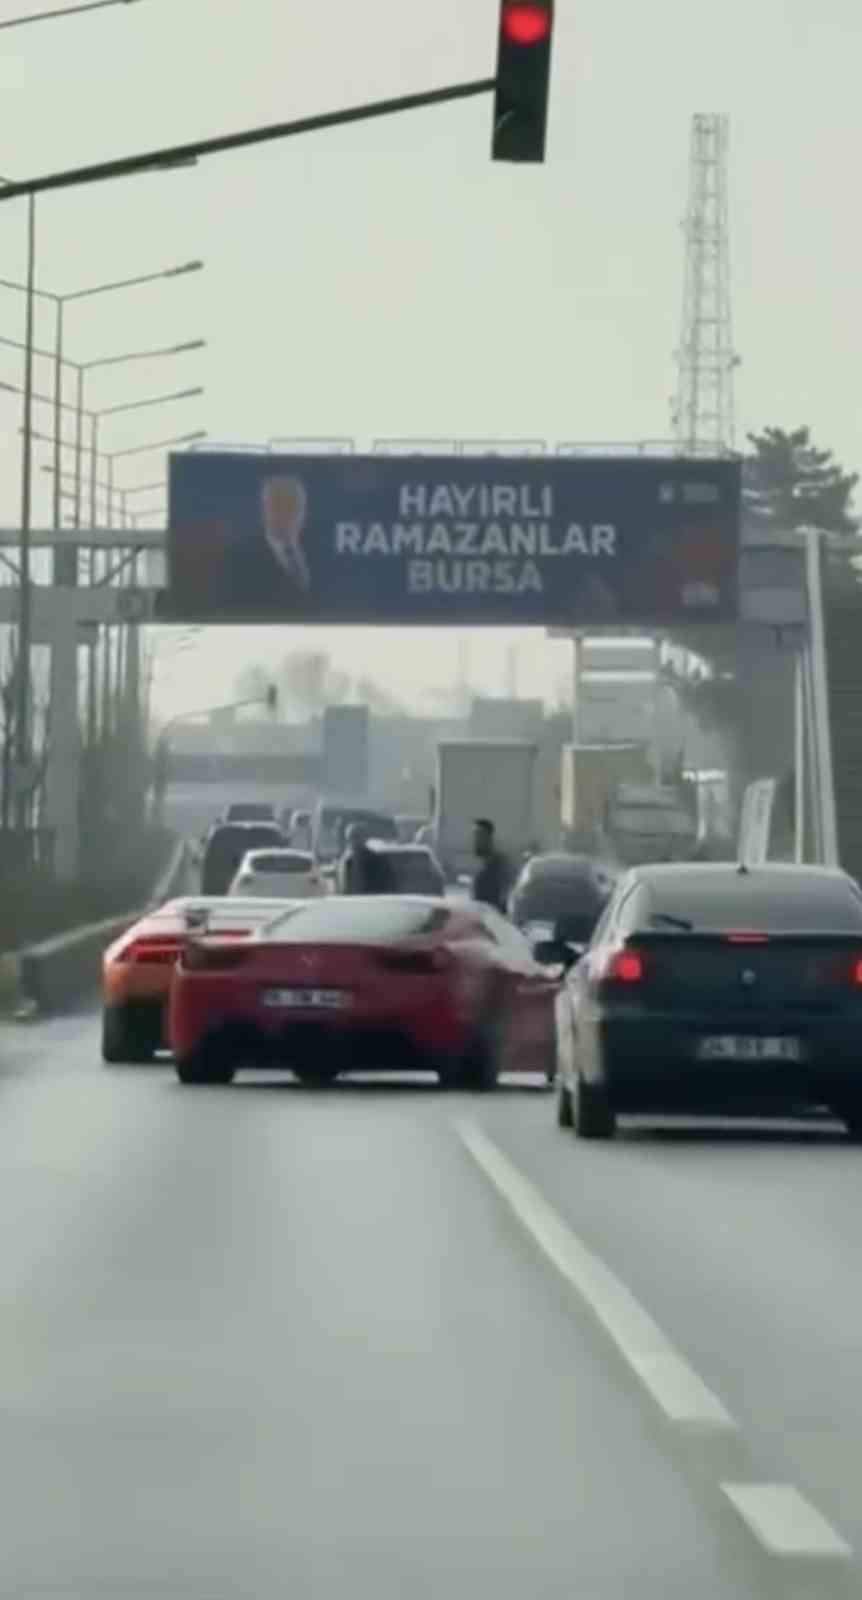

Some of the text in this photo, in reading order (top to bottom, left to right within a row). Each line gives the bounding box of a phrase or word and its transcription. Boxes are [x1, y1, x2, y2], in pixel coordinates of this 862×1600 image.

[399, 484, 552, 516] HAYIRLI
[335, 522, 616, 555] RAMAZANLAR
[408, 560, 542, 592] BURSA
